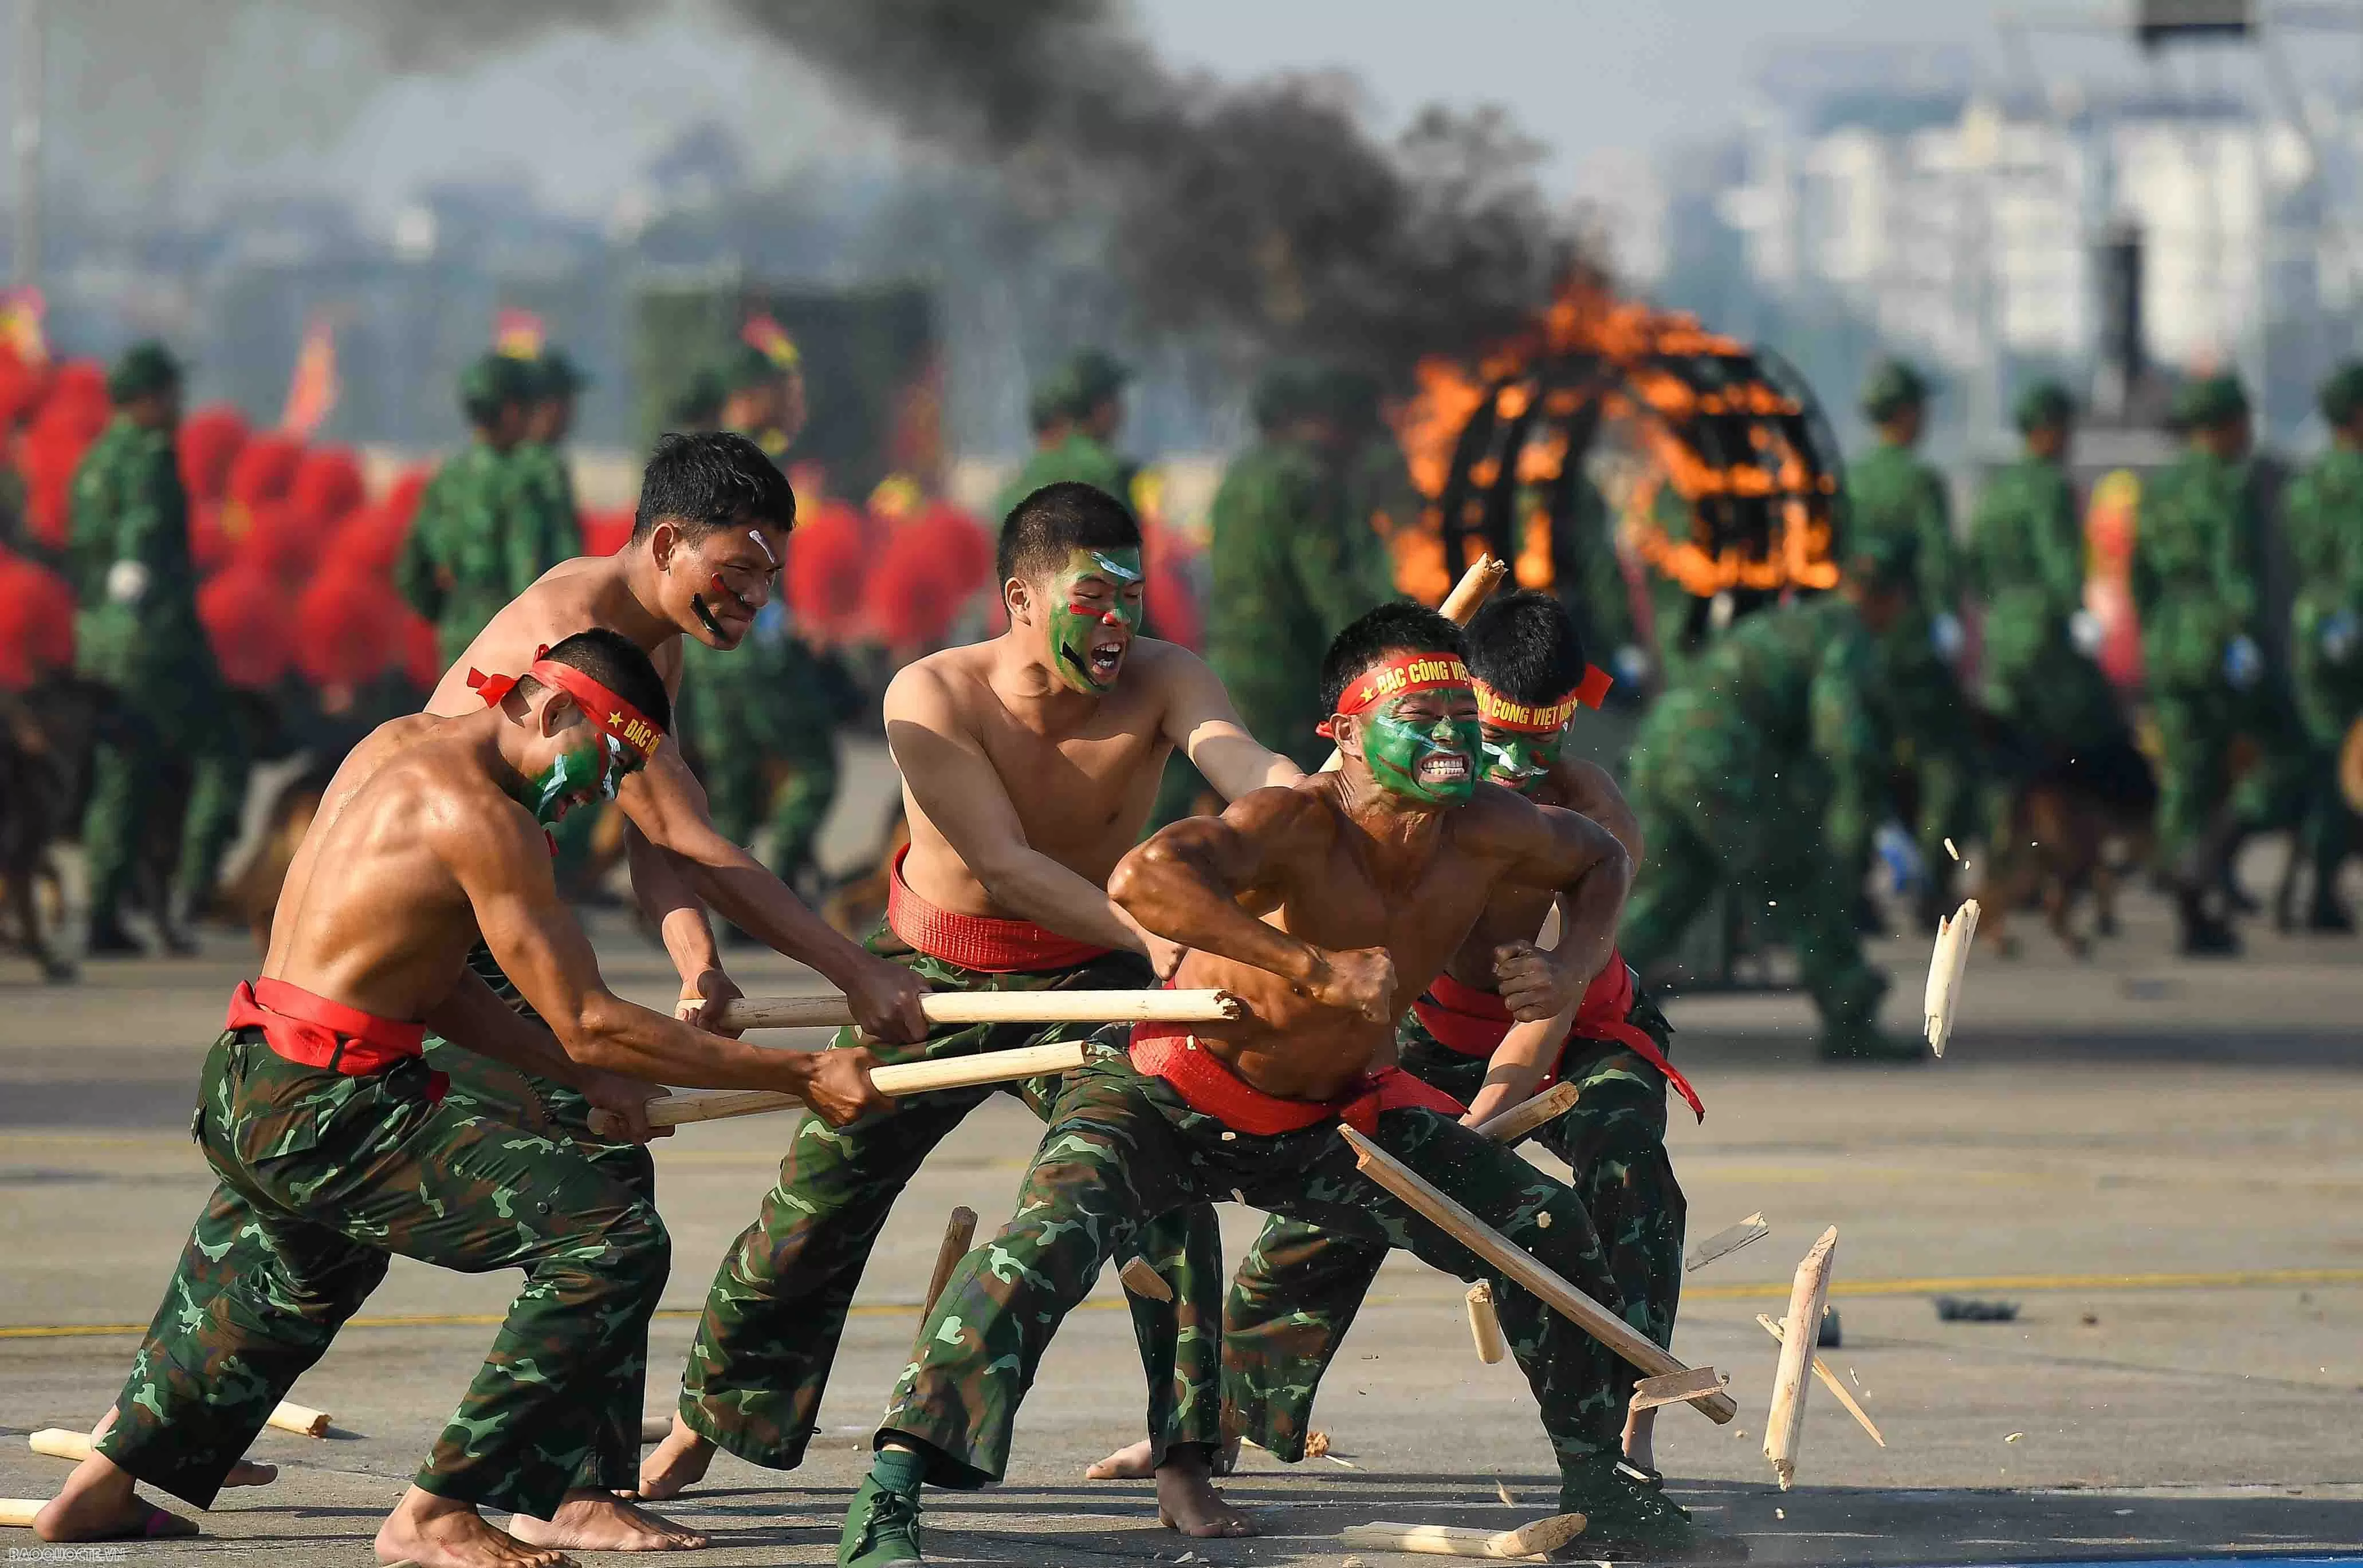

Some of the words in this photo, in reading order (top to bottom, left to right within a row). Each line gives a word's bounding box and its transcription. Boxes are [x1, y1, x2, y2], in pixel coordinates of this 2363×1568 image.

[1408, 659, 1449, 683] CÔNG
[1491, 698, 1530, 724] CÔNG
[623, 719, 651, 747] ĐẶC
